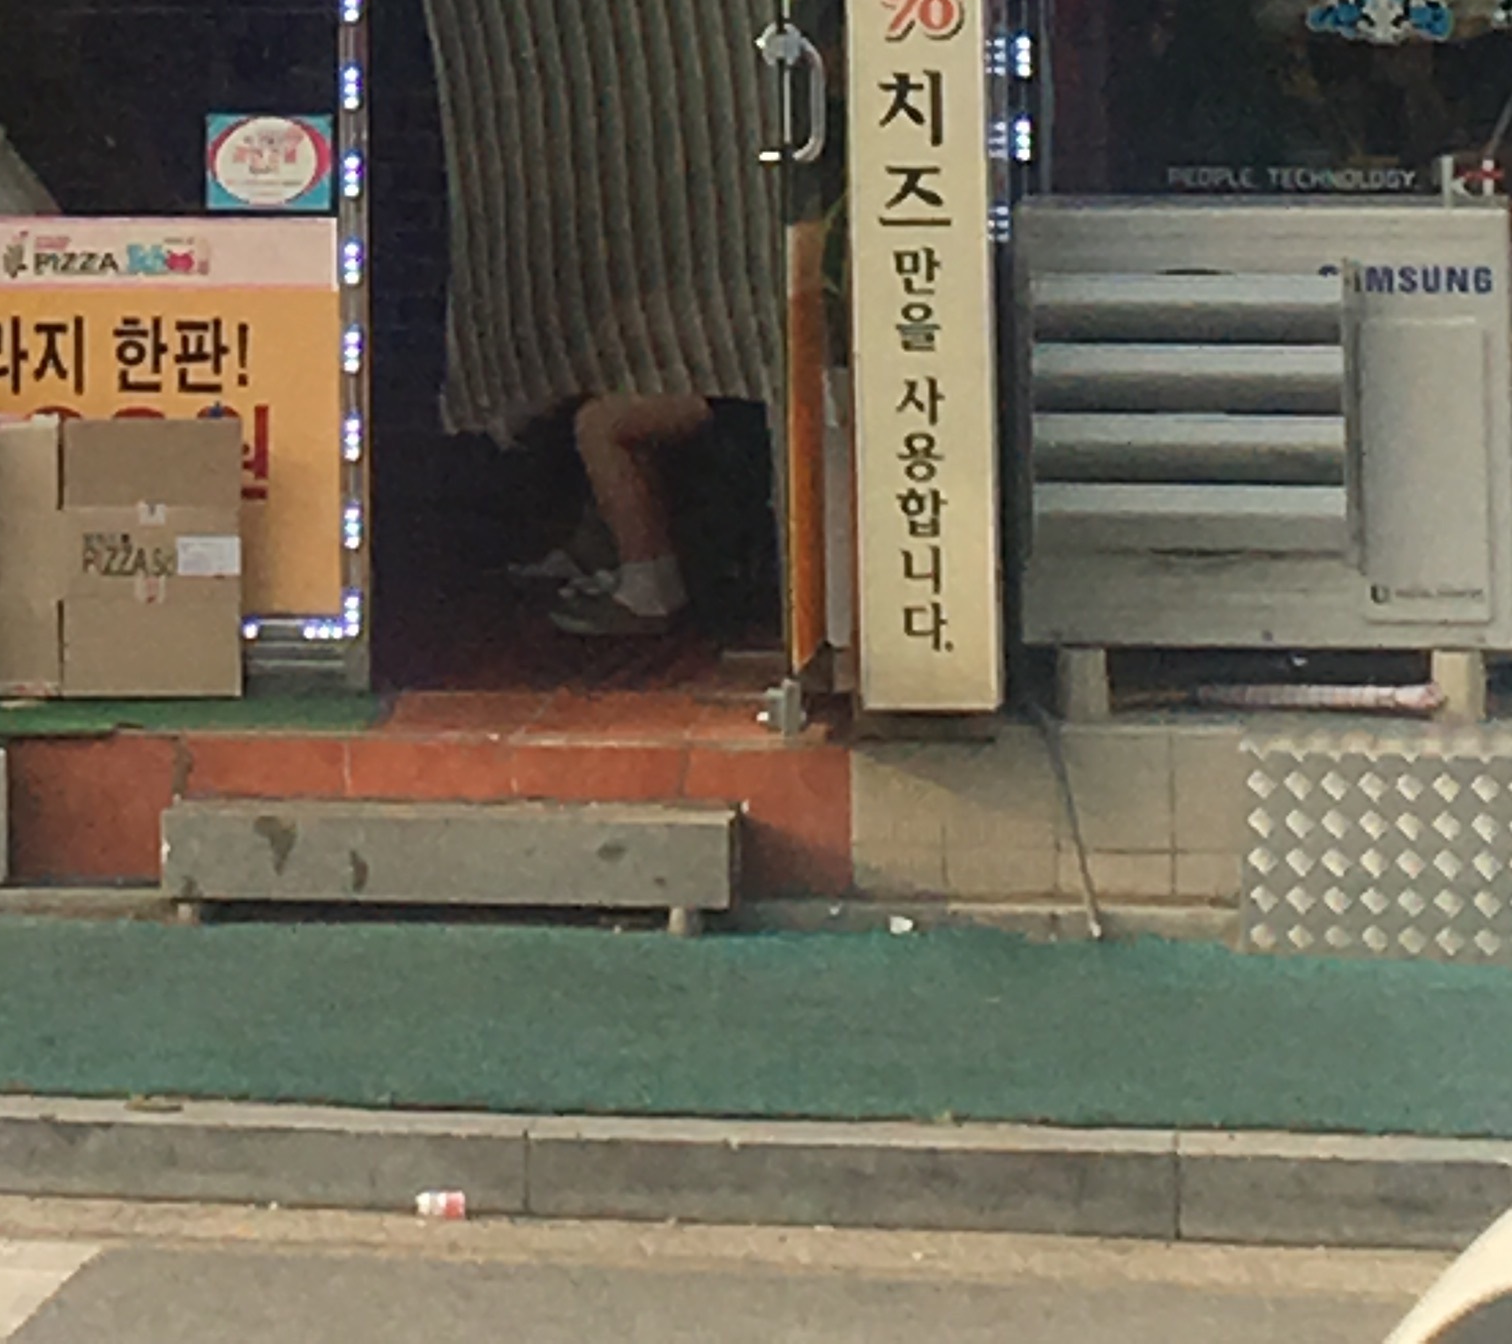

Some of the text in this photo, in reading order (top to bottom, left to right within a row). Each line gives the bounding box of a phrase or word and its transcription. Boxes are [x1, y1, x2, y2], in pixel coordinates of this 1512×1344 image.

[33, 250, 120, 276] PIZZA
[113, 315, 251, 394] 한판!
[894, 375, 955, 653] 사용합니다.
